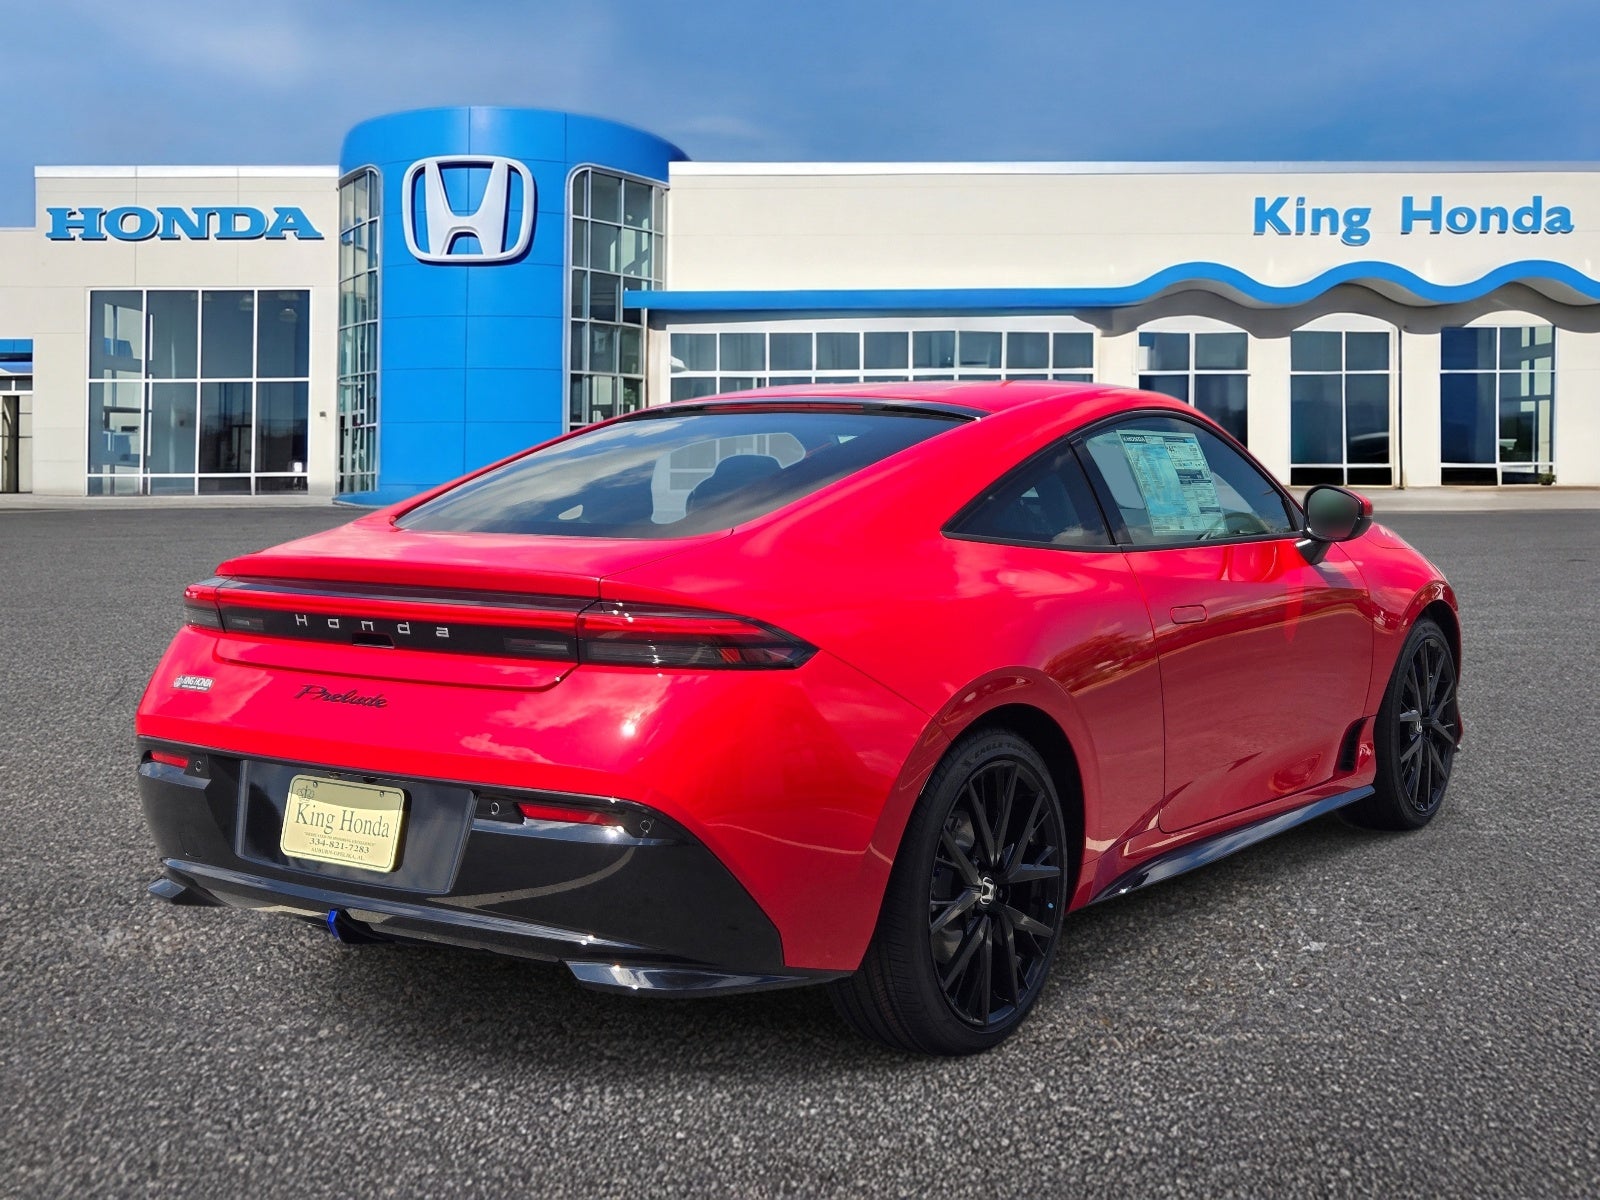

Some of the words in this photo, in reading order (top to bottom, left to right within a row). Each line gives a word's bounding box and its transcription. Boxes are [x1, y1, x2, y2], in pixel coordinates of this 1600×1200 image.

[46, 206, 324, 241] HONDA
[1253, 196, 1372, 246] King
[1400, 195, 1575, 234] Honda
[295, 684, 388, 708] Prelude
[296, 803, 335, 834] King
[339, 809, 390, 838] Honda
[309, 837, 370, 854] 334-821-7283
